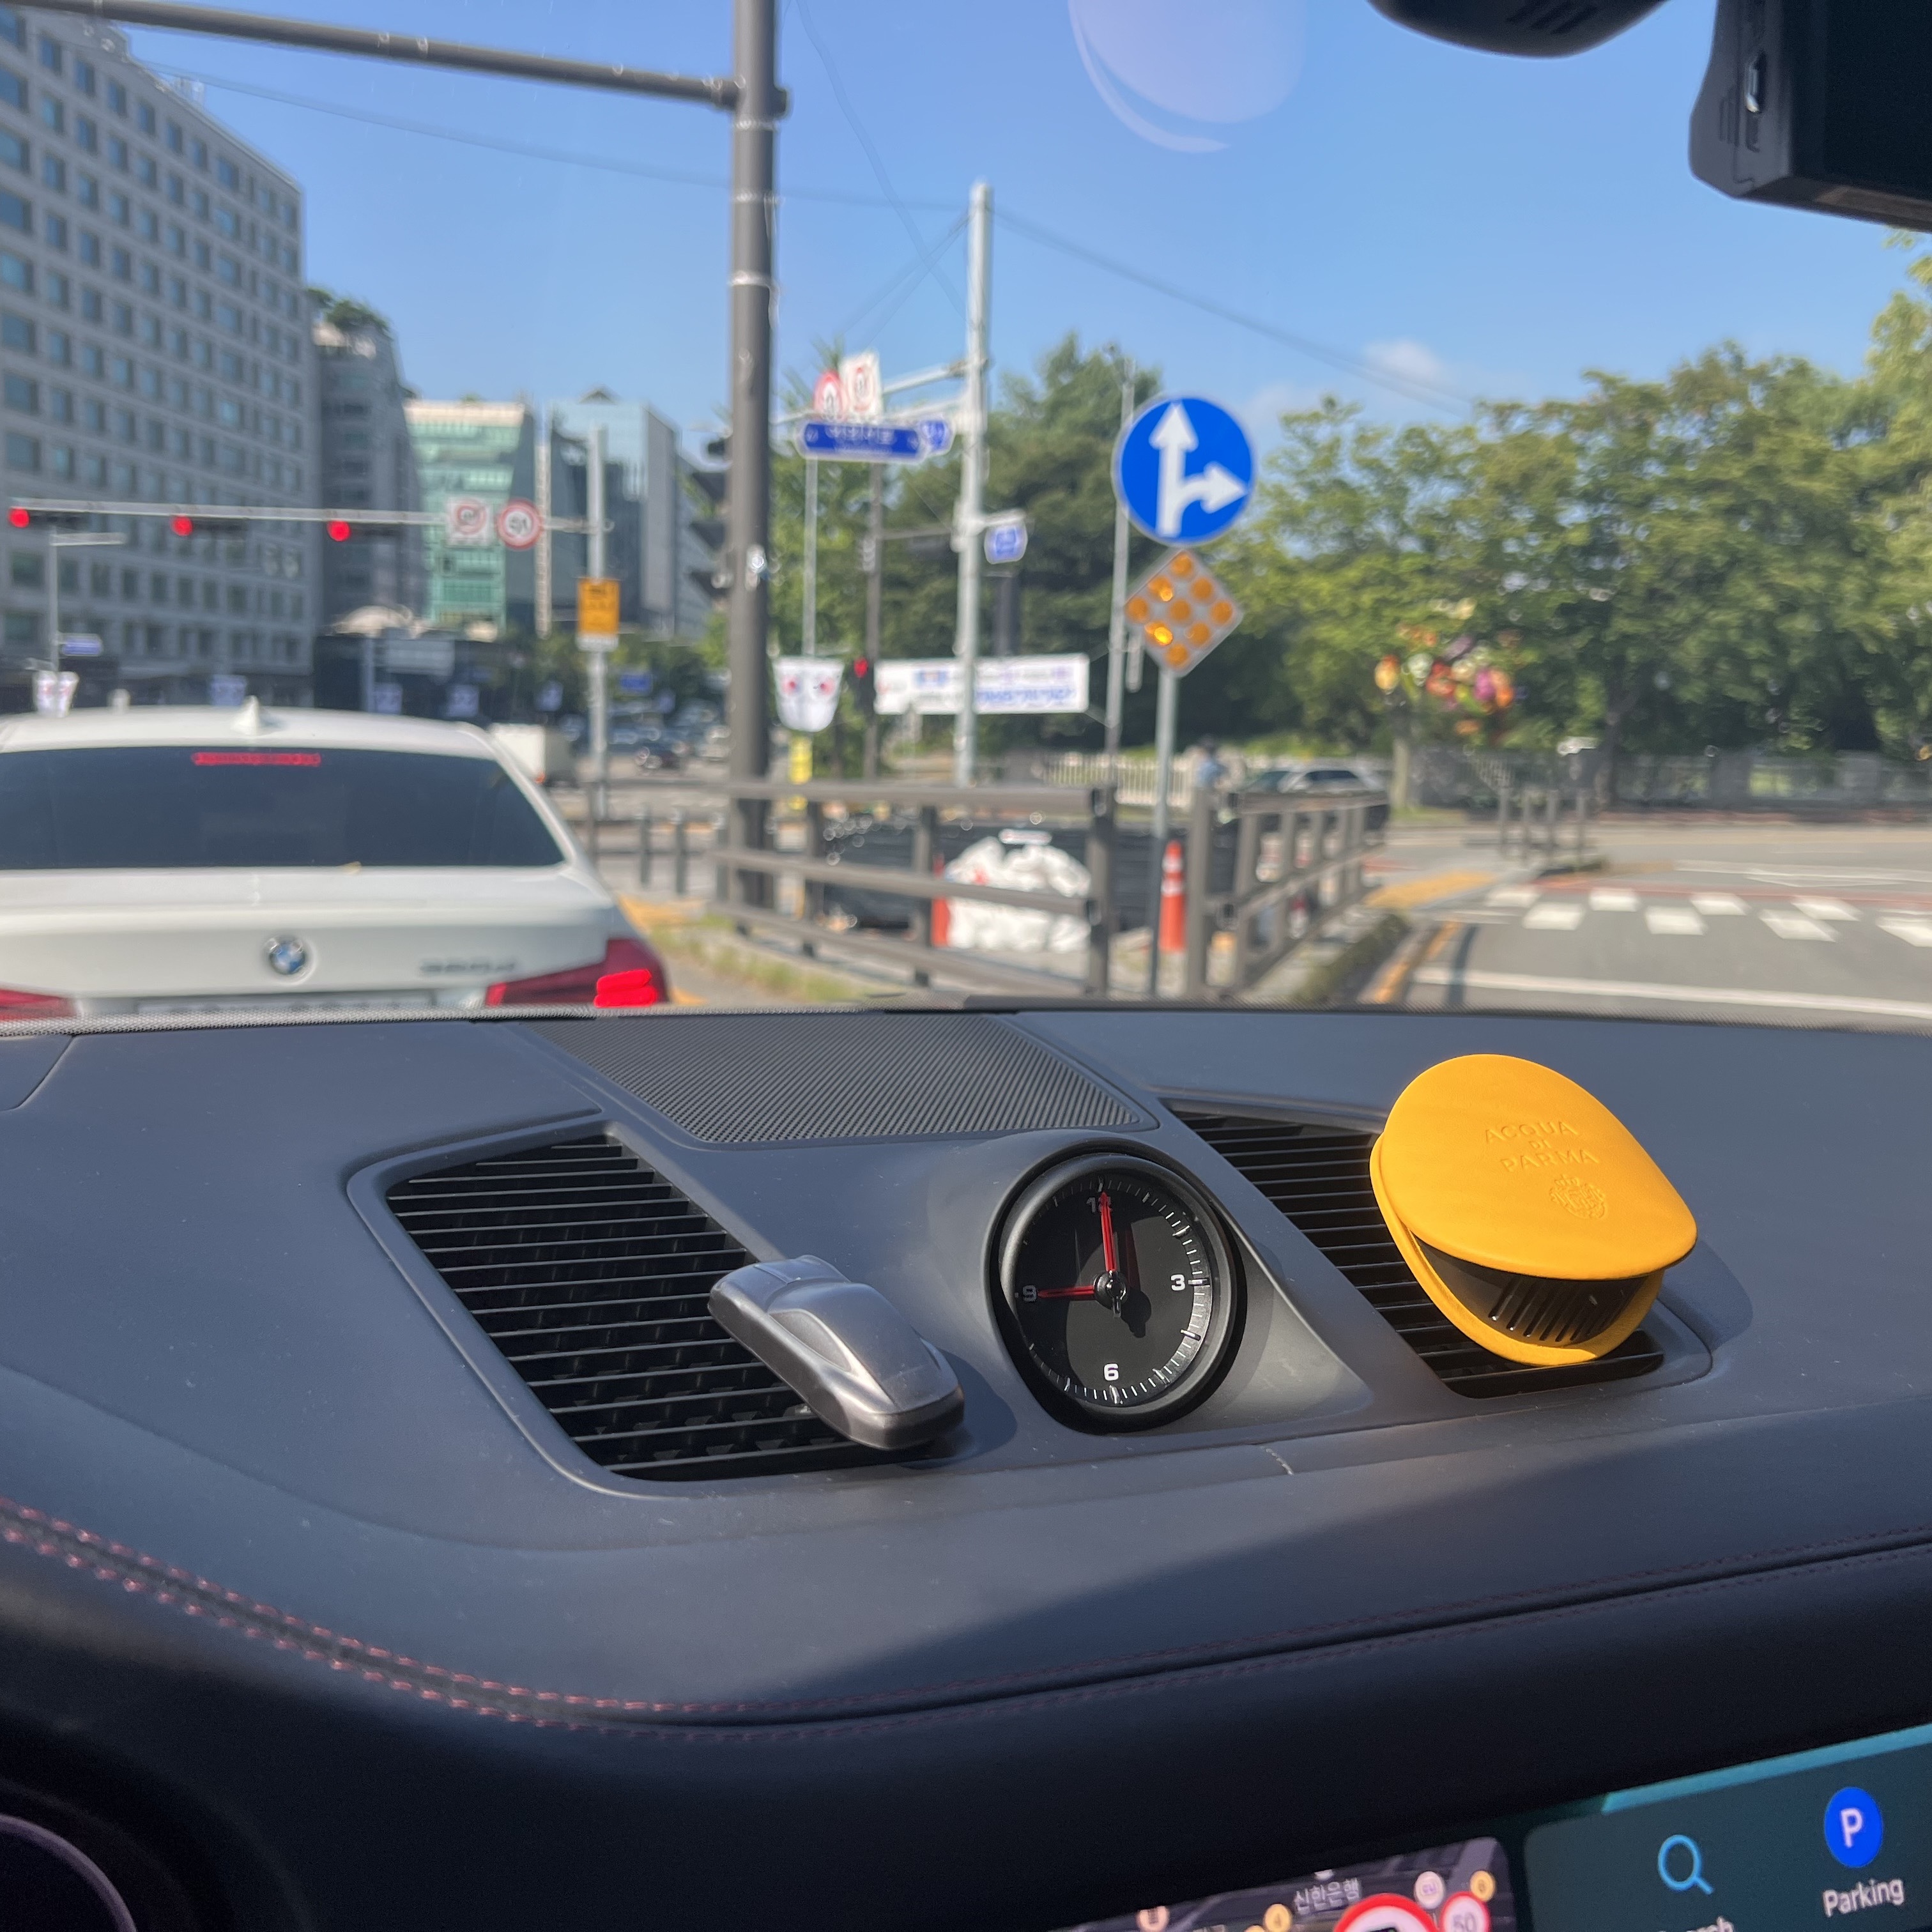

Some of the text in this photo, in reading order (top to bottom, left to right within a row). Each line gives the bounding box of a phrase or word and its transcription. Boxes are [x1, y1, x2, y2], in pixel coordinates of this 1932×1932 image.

[1485, 1121, 1579, 1144] ACQUA
[1528, 1139, 1552, 1149] DI
[1501, 1149, 1599, 1173] PARMA
[1022, 1284, 1037, 1303] 9
[1170, 1274, 1186, 1291] 3
[1103, 1363, 1119, 1381] 6
[1840, 1807, 1864, 1849] P
[1293, 1877, 1360, 1915] 신한은행
[1822, 1877, 1906, 1917] Parking
